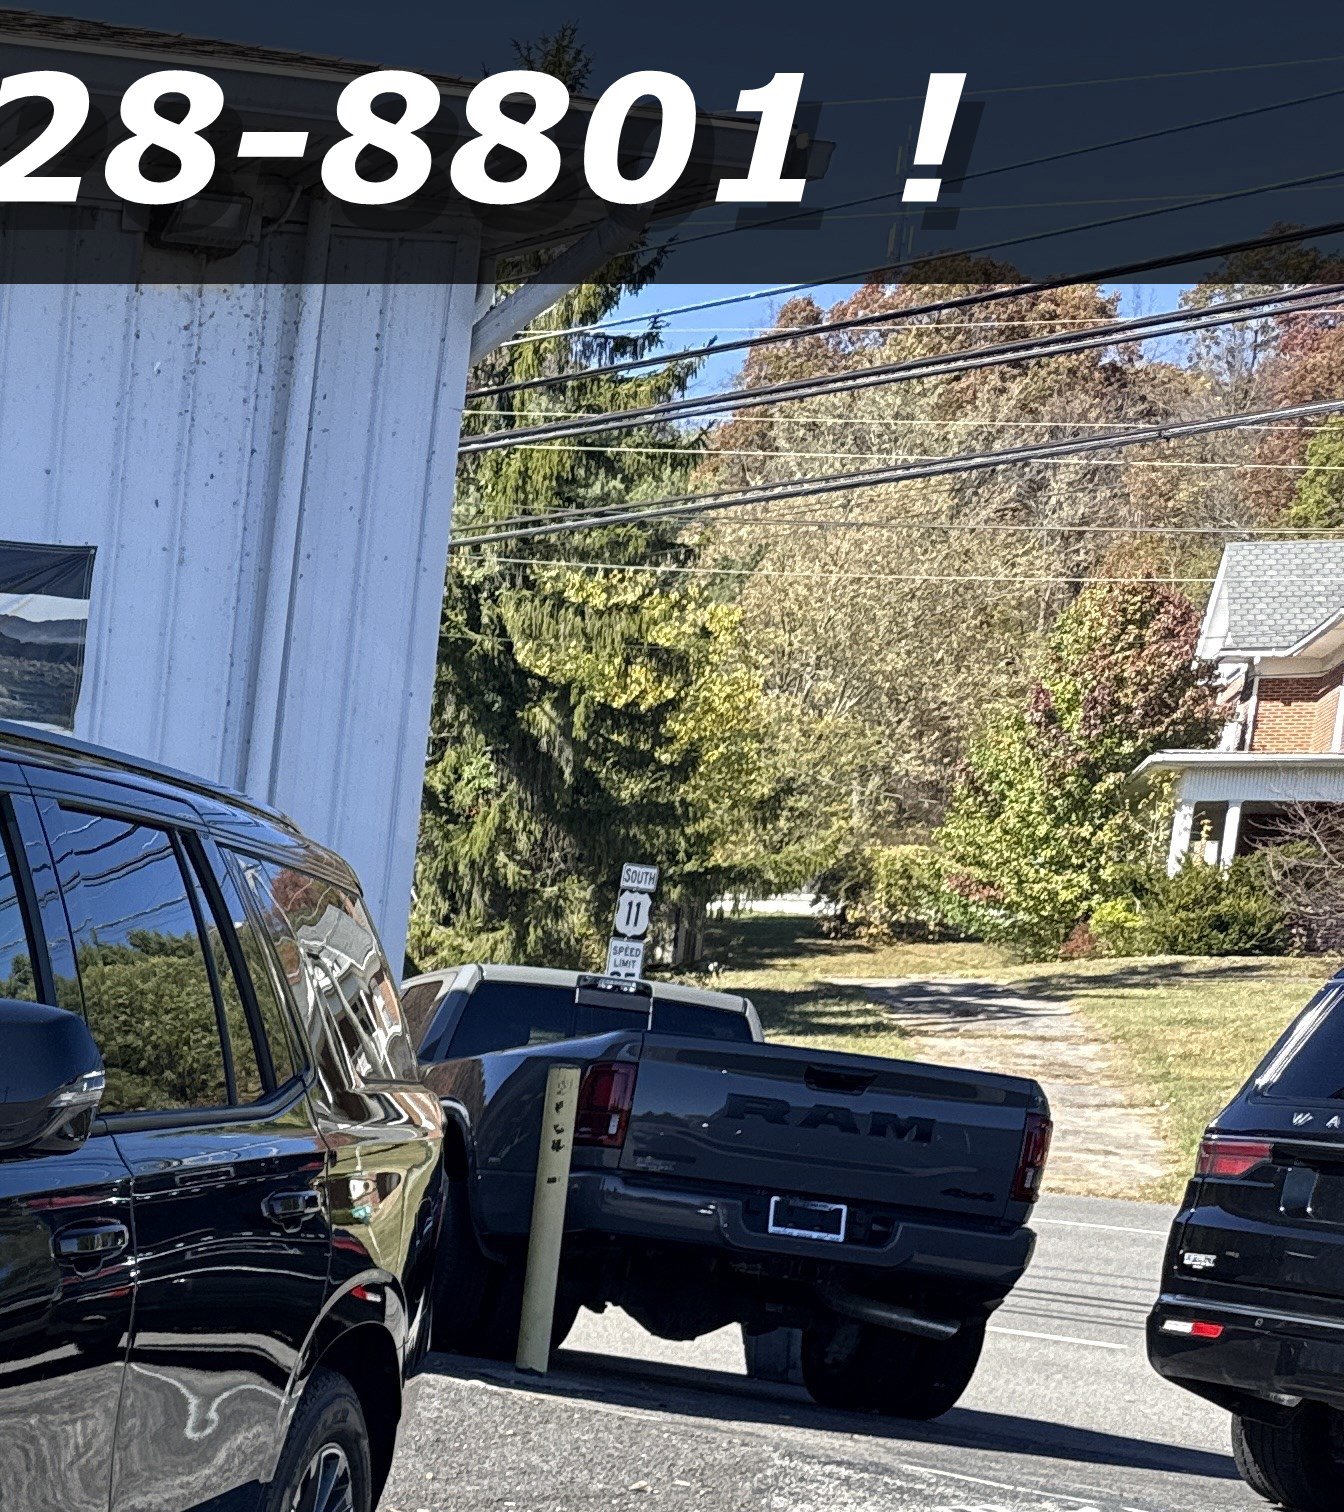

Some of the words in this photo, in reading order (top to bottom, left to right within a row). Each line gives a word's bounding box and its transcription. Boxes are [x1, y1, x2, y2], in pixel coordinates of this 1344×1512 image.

[623, 867, 656, 886] SOUTH
[625, 900, 642, 927] 11
[612, 943, 641, 958] SPEED
[613, 959, 636, 969] LIMIT
[724, 1092, 937, 1142] RAM
